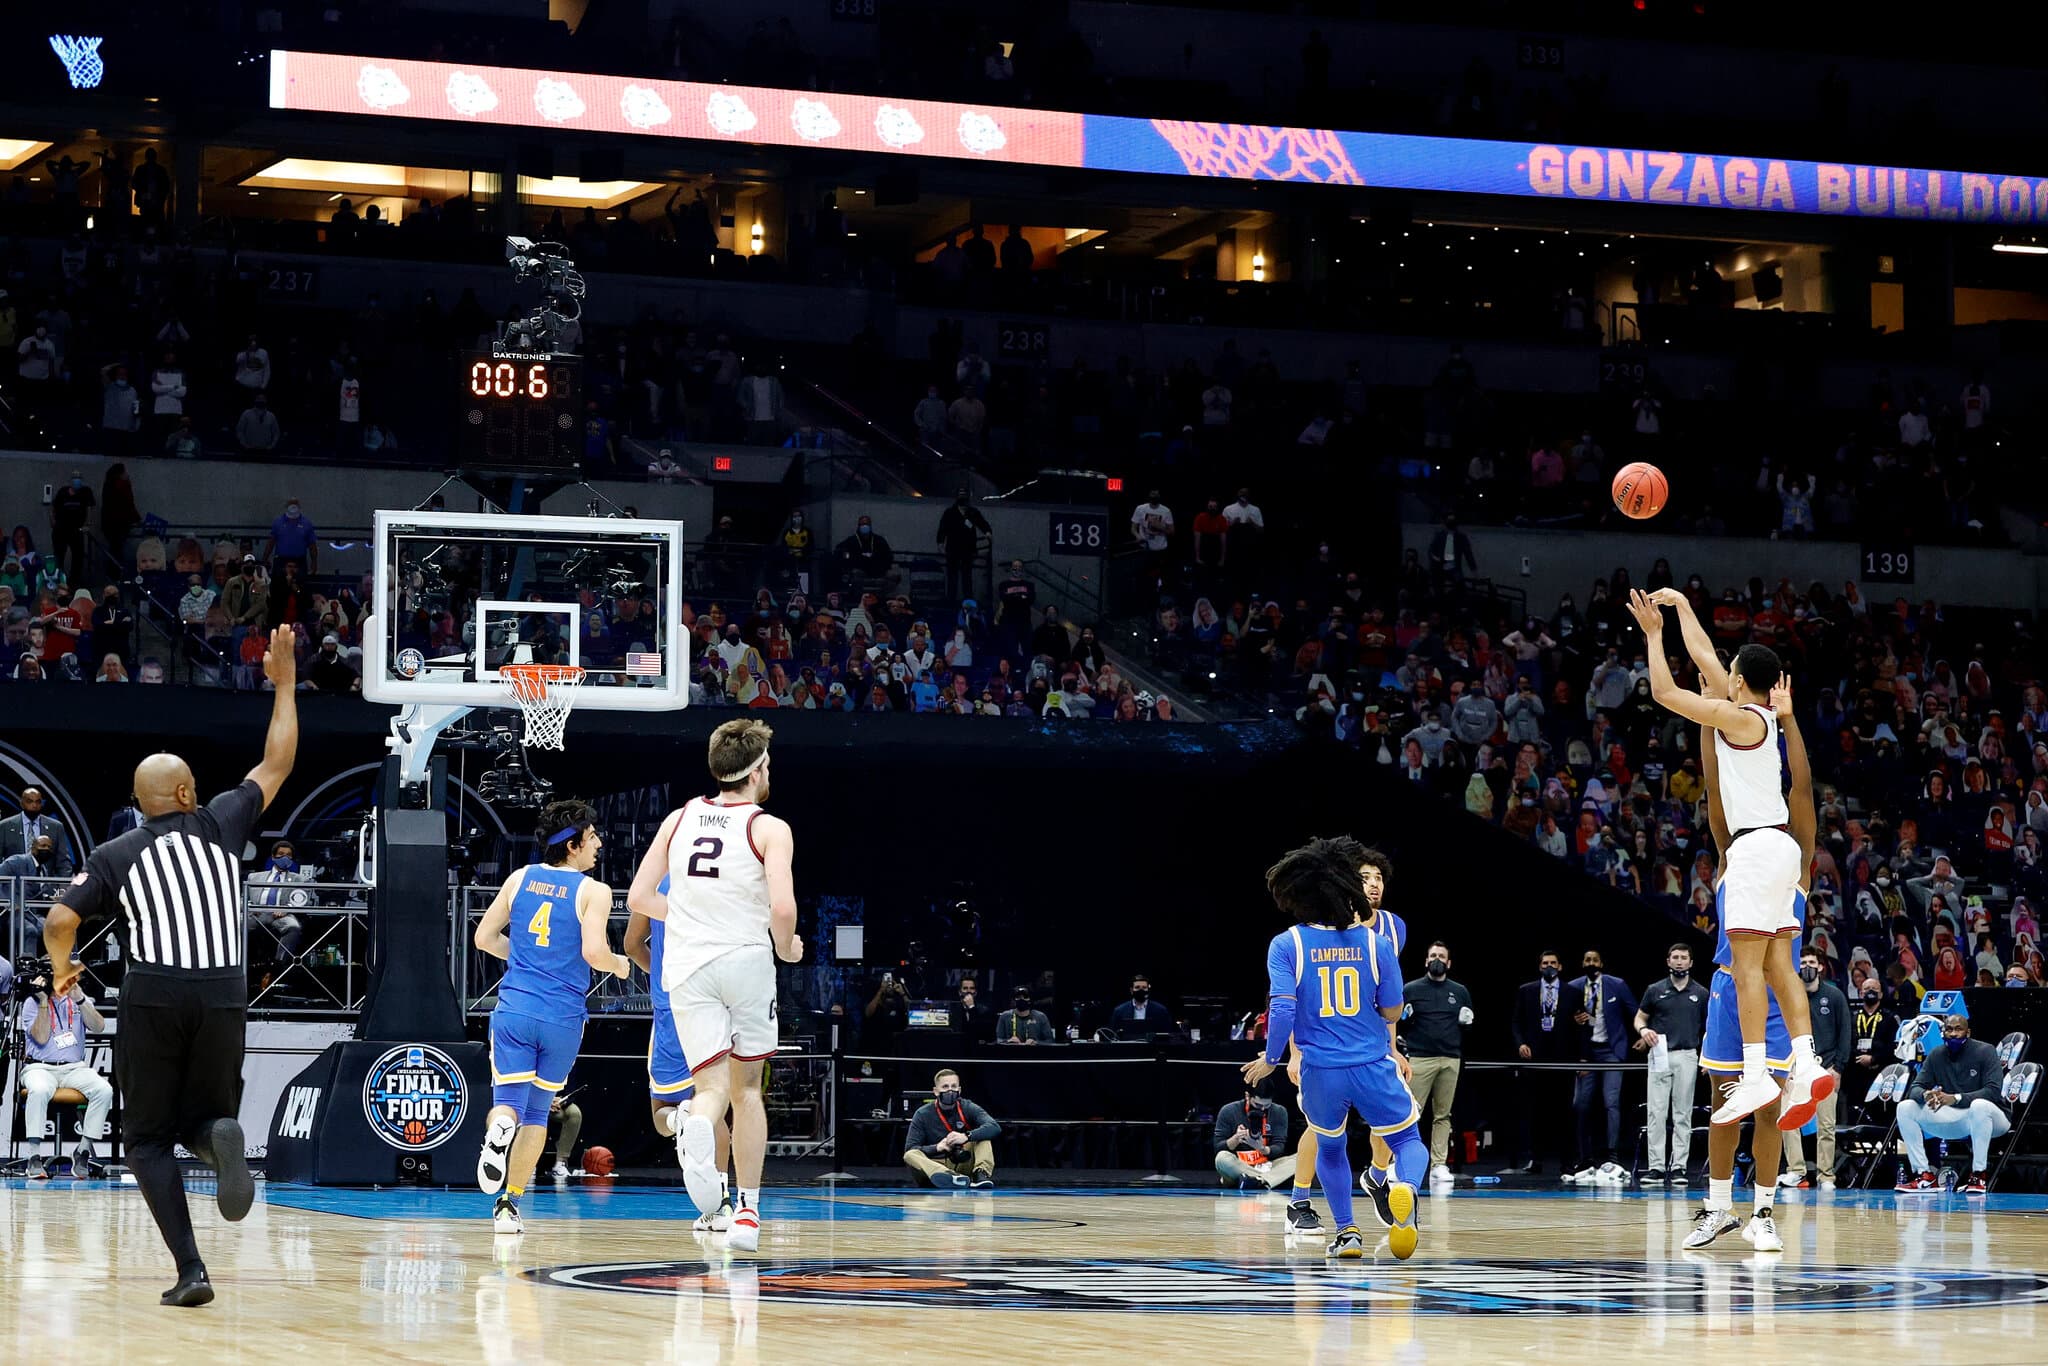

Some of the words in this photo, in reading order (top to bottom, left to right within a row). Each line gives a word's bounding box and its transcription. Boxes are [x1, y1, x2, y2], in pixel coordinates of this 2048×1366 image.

[1520, 44, 1561, 65] 339
[1528, 145, 1795, 210] GONZAGA
[268, 269, 313, 293] 237
[1002, 329, 1046, 351] 238
[492, 352, 552, 361] DAKTRONICS
[471, 362, 548, 398] 00.6
[1055, 522, 1100, 547] 138
[1866, 552, 1908, 574] 139
[698, 814, 731, 829] TIMME
[687, 836, 723, 878] 2
[525, 879, 556, 897] JAQUEZ
[527, 900, 553, 947] 4
[1310, 947, 1363, 963] CAMPBELL
[1317, 967, 1361, 1017] 10
[385, 1074, 446, 1095] FINAL
[278, 1086, 322, 1139] NCAA
[386, 1098, 445, 1120] FOUR
